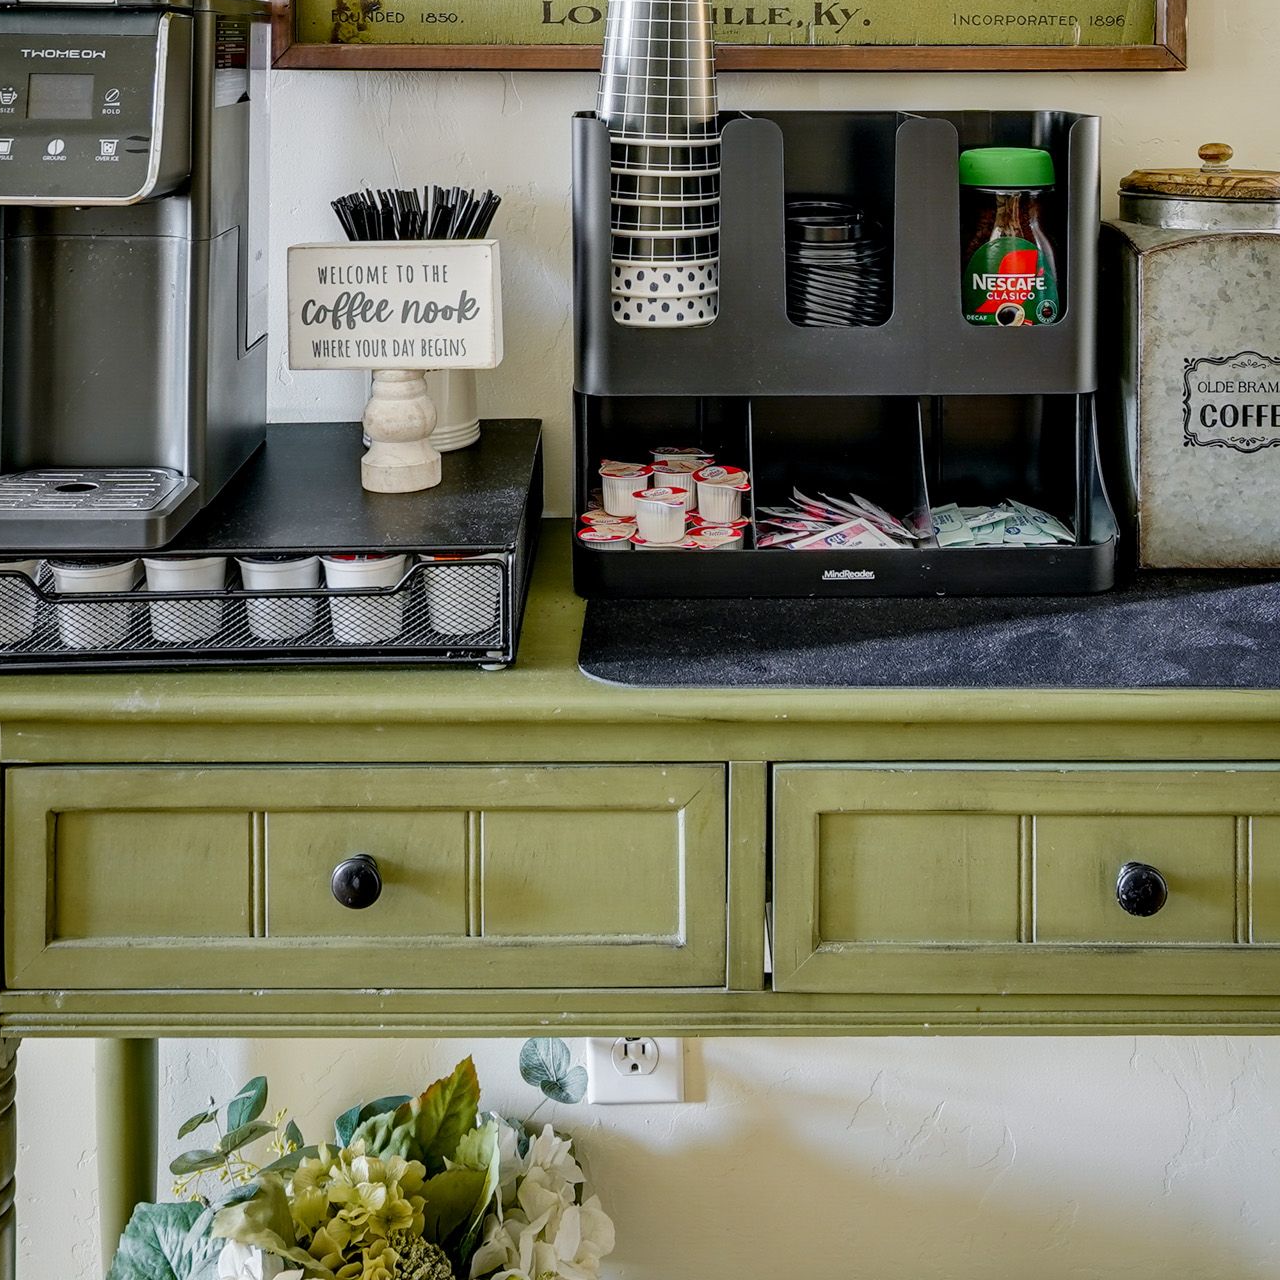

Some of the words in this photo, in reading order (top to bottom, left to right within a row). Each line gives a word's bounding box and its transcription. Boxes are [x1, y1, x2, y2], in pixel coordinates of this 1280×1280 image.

[331, 8, 406, 24] FOUNDED
[420, 11, 465, 24] 1850.
[813, 1, 872, 35] Ky.
[952, 12, 1079, 27] INCORPORATED
[21, 49, 106, 59] TWOMEOW
[317, 265, 389, 285] WELCOME
[396, 265, 414, 284] TO
[422, 264, 448, 284] THE
[986, 290, 1036, 300] CLÁSICO
[301, 291, 394, 330] coffee
[401, 289, 481, 324] nook
[311, 338, 351, 359] WHERE
[356, 338, 388, 358] YOUR
[392, 337, 415, 358] DAY
[420, 337, 467, 358] BEGINS
[1197, 381, 1235, 393] OLDE
[824, 569, 875, 579] MindReader
